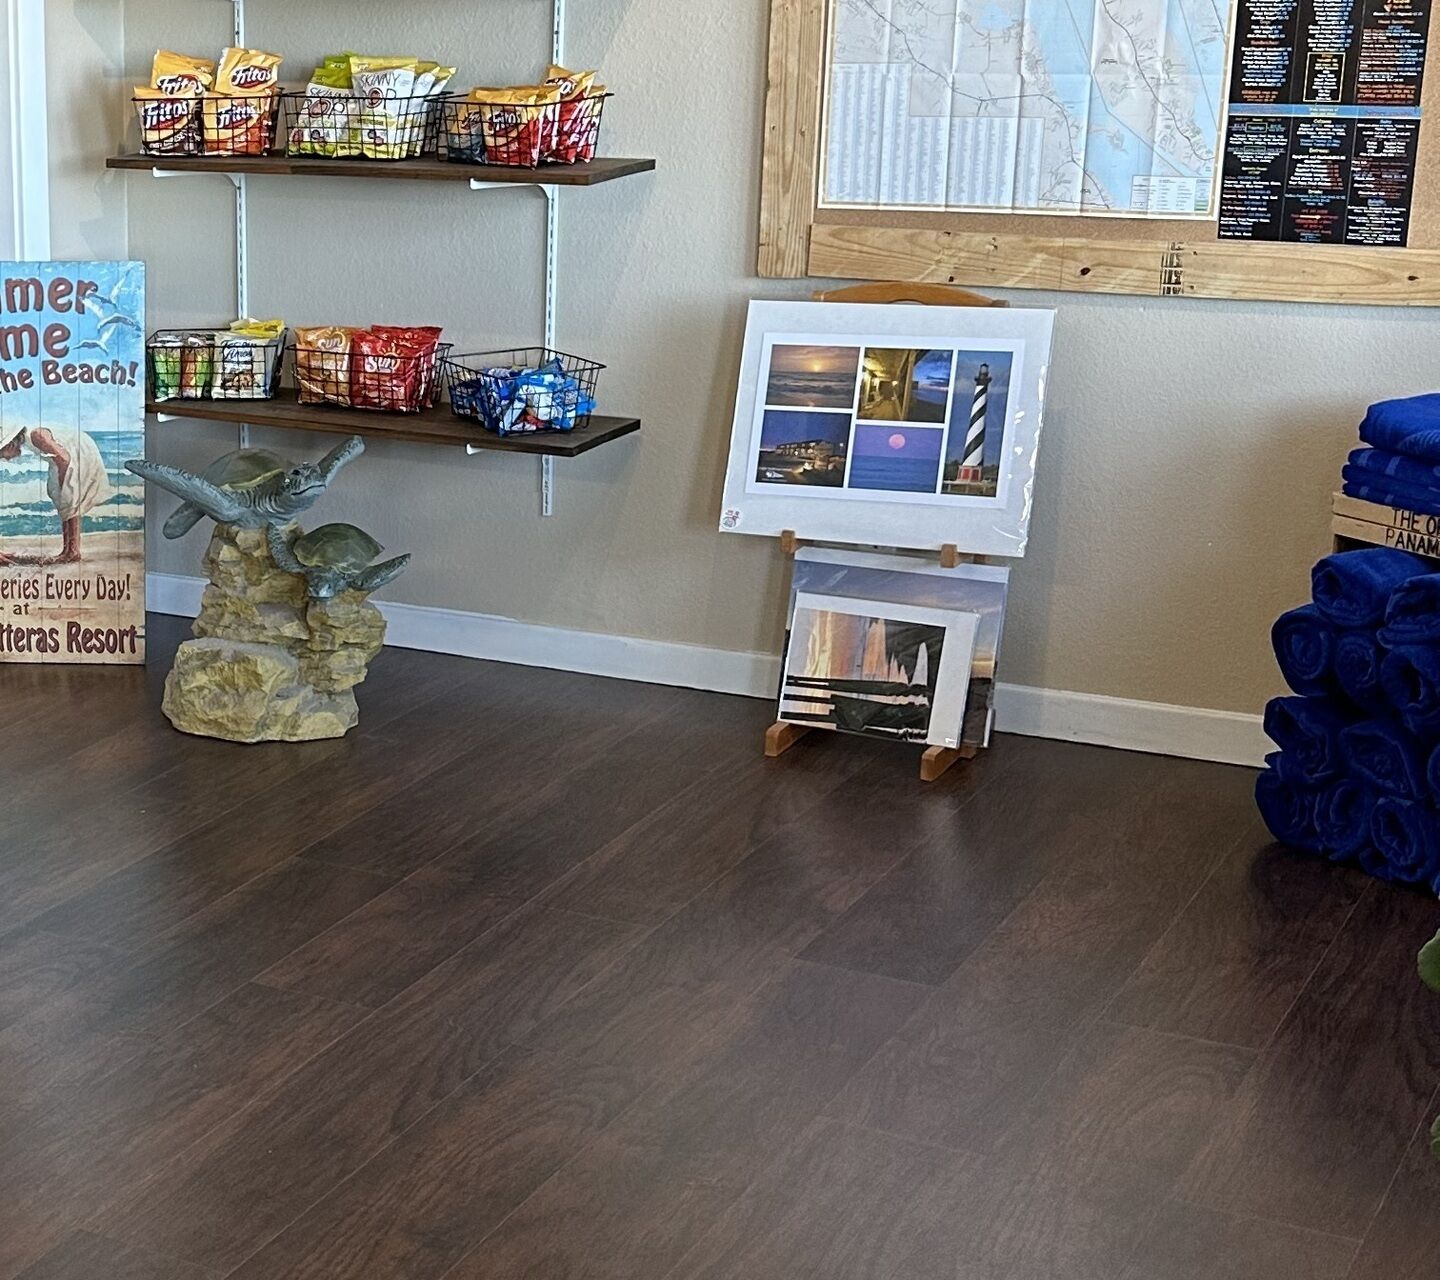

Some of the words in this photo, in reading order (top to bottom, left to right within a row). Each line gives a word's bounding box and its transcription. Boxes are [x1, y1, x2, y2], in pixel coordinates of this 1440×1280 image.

[231, 66, 272, 87] Fritos
[360, 73, 400, 87] SKINNY
[142, 100, 189, 129] Fritos
[41, 359, 140, 388] Beach!
[1392, 507, 1420, 533] THE
[45, 573, 91, 601] Every
[96, 573, 131, 601] Day!
[12, 601, 31, 616] at
[66, 621, 137, 655] Resort
